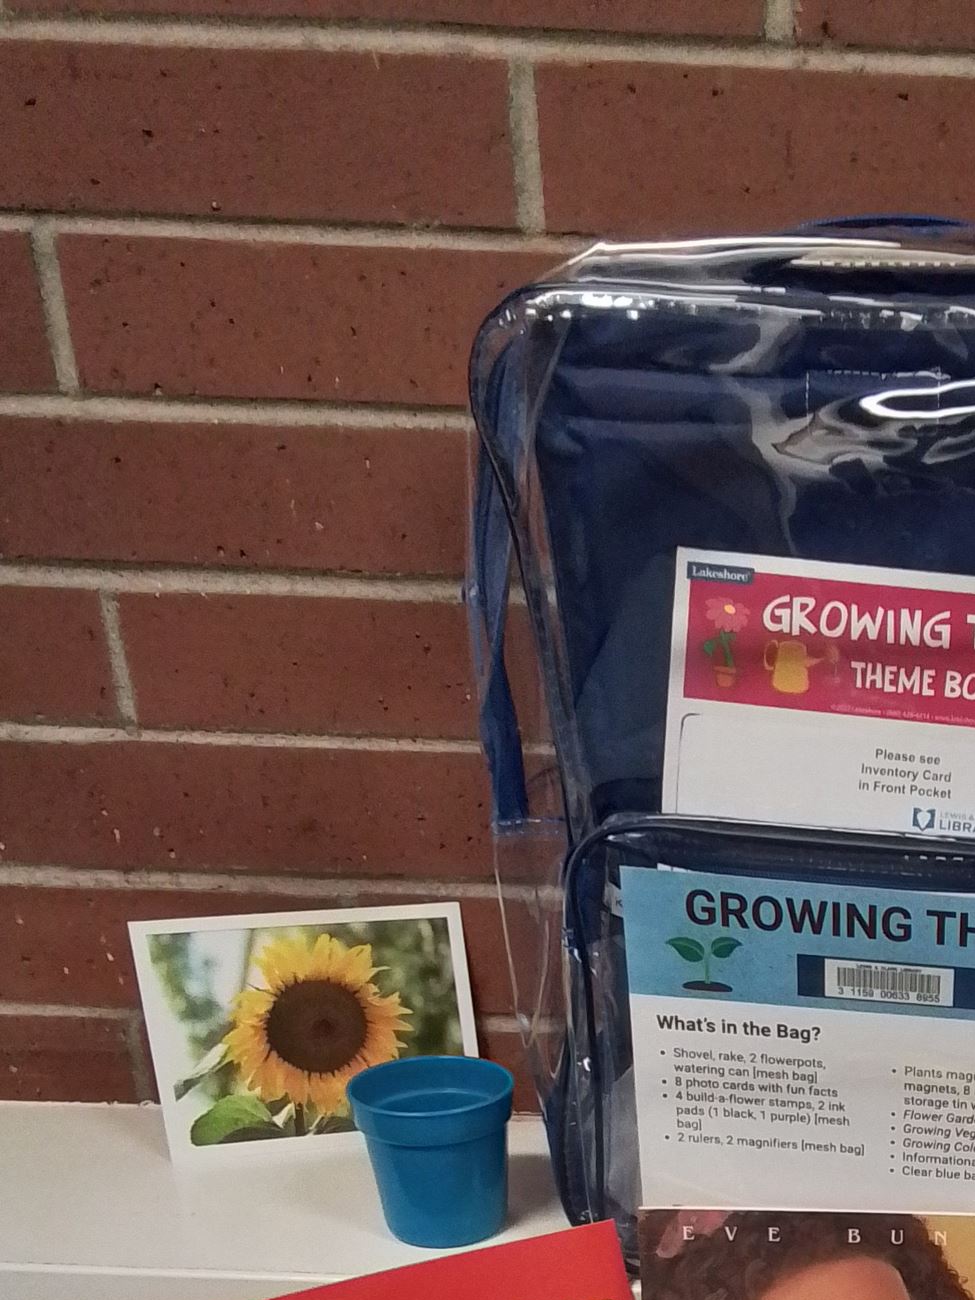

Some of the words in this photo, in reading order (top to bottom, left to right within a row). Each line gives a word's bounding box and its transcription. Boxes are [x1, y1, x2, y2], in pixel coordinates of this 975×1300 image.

[692, 565, 748, 581] Lakeshore
[762, 594, 951, 648] GROWING
[851, 660, 935, 696] THEME
[875, 748, 915, 763] Please
[920, 754, 940, 765] see
[861, 763, 918, 781] Inventory
[922, 769, 951, 783] Card
[858, 780, 869, 791] in
[873, 781, 905, 795] Front
[910, 784, 951, 799] Pocket
[685, 889, 912, 942] GROWING
[838, 987, 844, 995] 3
[656, 1014, 716, 1033] What's
[721, 1019, 737, 1035] in
[743, 1021, 771, 1037] the
[777, 1023, 821, 1044] Bag?
[673, 1047, 715, 1062] Shovel,
[718, 1051, 746, 1064] rake,
[749, 1053, 757, 1063] 2
[760, 1053, 826, 1070] flowerpots,
[674, 1063, 725, 1077] watering
[728, 1067, 750, 1077] can
[753, 1068, 789, 1080] [mesh
[792, 1071, 818, 1084] bag]
[904, 1065, 942, 1079] Plants
[675, 1077, 682, 1087] 8
[685, 1078, 720, 1091] photo
[722, 1080, 755, 1091] cards
[758, 1082, 783, 1094] with
[786, 1083, 805, 1095] fun
[808, 1085, 838, 1098] facts
[903, 1081, 960, 1095] magnets,
[963, 1085, 970, 1095] 8
[675, 1091, 683, 1100] 4
[686, 1091, 765, 1106] build-a-flower
[768, 1097, 815, 1111] stamps,
[818, 1101, 825, 1110] 2
[828, 1101, 845, 1112] ink
[903, 1096, 949, 1110] storage
[952, 1099, 967, 1109] tin
[676, 1105, 705, 1118] pads
[708, 1106, 718, 1118] (1
[723, 1107, 756, 1120] black,
[760, 1110, 766, 1120] 1
[770, 1111, 811, 1125] purple)
[814, 1113, 850, 1126] [mesh
[677, 1118, 702, 1131] bag]
[903, 1109, 943, 1122] Flower
[903, 1124, 951, 1138] Growing
[677, 1133, 685, 1142] 2
[688, 1133, 724, 1146] rulers,
[726, 1136, 733, 1145] 2
[737, 1137, 798, 1150] magnifiers
[801, 1140, 837, 1153] [mesh
[840, 1143, 865, 1156] bag]
[902, 1138, 950, 1153] Growing
[902, 1165, 932, 1177] Clear
[935, 1167, 960, 1180] blue
[682, 1225, 781, 1242] EVE
